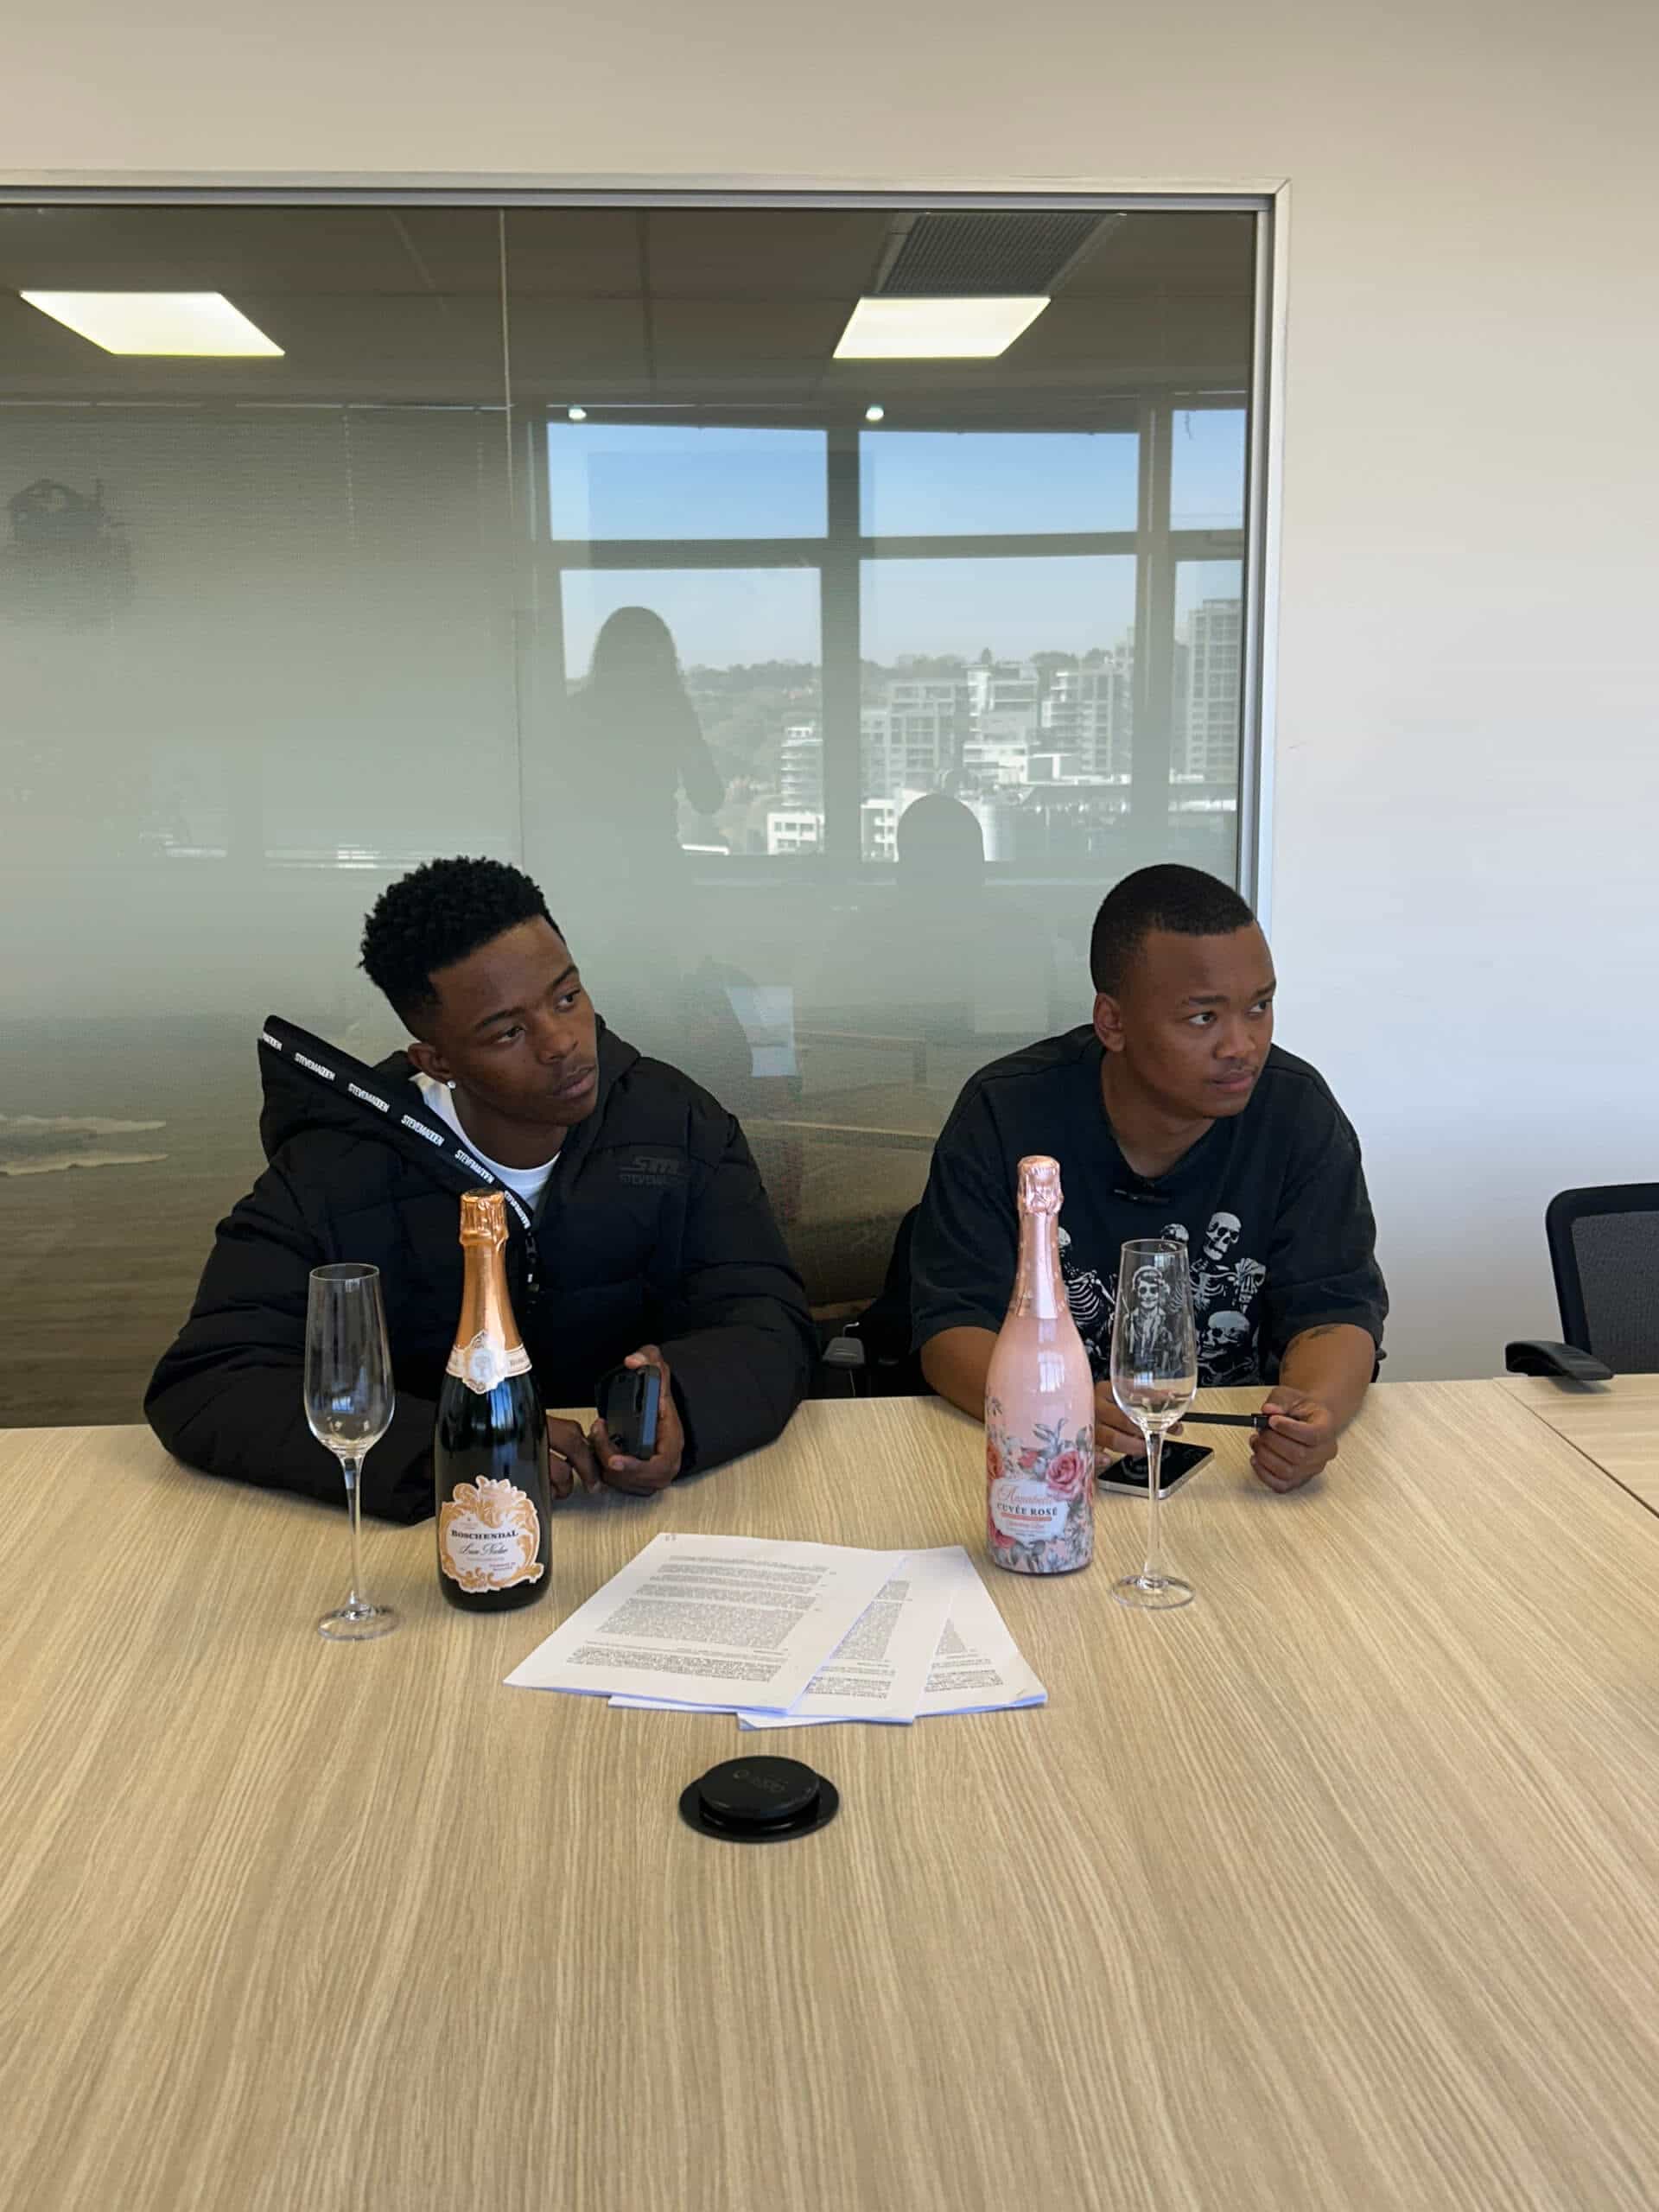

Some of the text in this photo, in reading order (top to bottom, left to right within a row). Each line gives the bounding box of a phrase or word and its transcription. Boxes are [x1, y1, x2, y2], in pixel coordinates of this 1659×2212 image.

[996, 1502, 1058, 1516] CUVÉE ROSÉ
[451, 1529, 518, 1540] BOSCHENDAL
